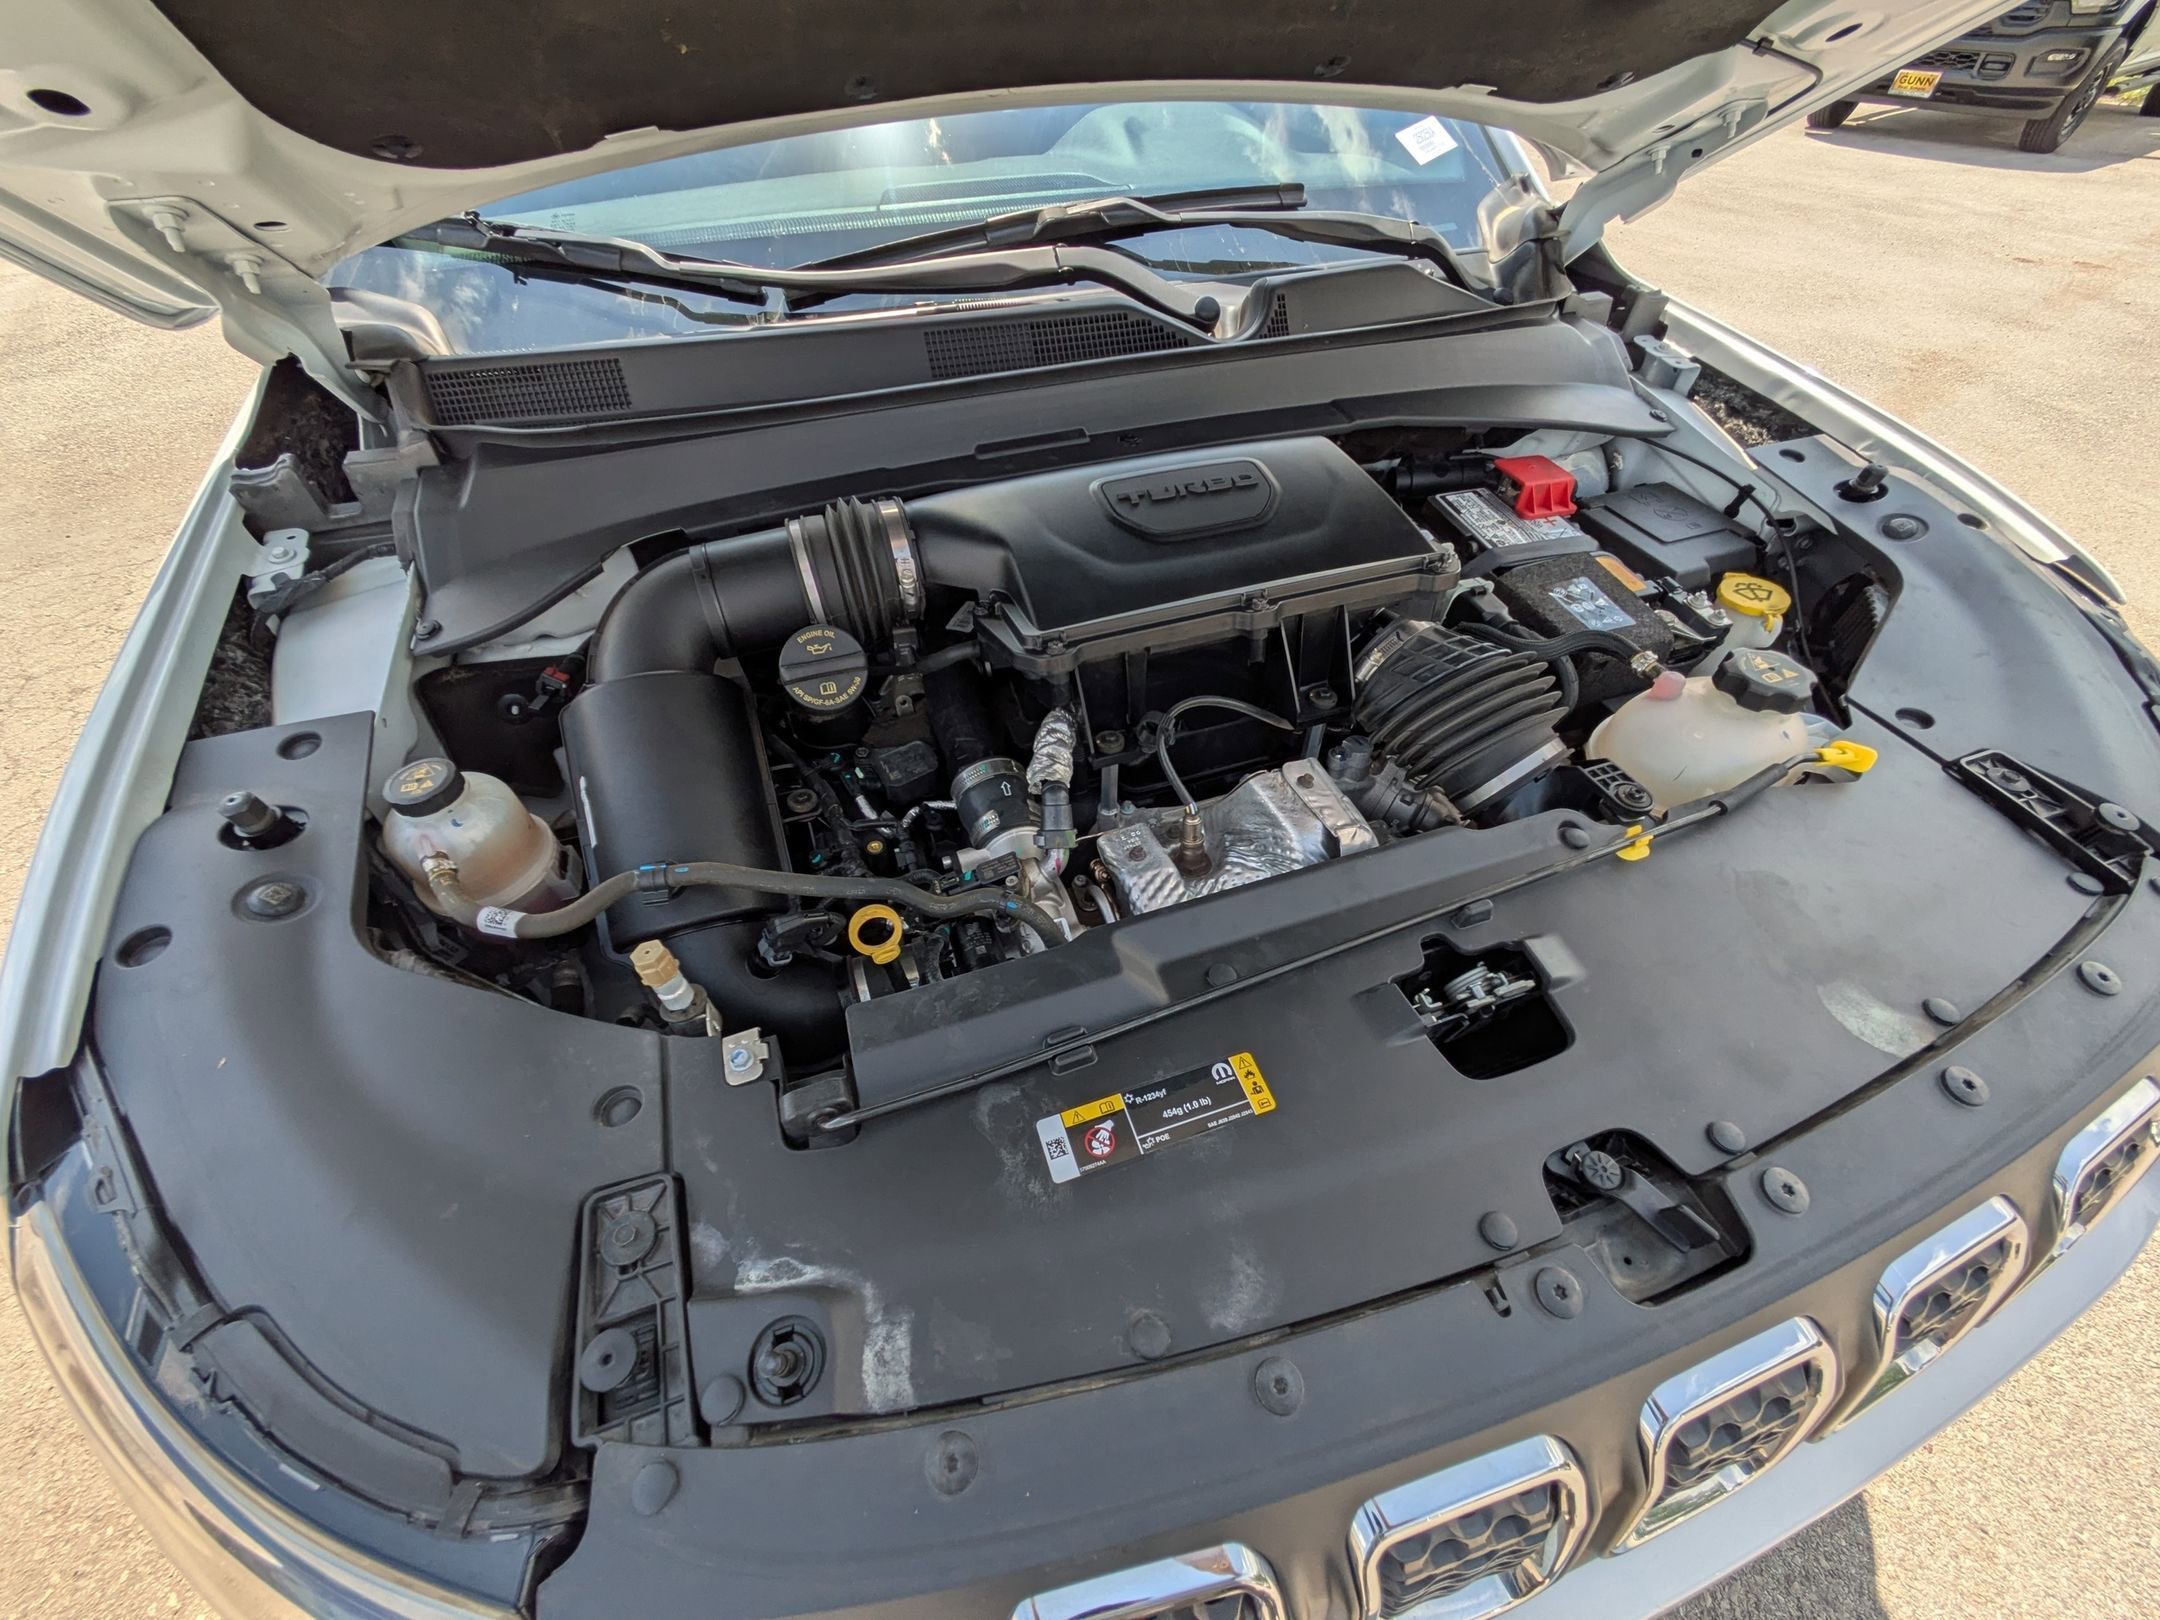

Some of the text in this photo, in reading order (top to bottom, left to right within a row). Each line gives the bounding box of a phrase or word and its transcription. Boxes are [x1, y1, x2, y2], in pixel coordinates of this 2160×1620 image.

[1899, 75, 1935, 87] GUNN
[1116, 473, 1260, 507] TURBO
[796, 629, 836, 644] ENGINE OIL
[792, 686, 804, 698] API
[1135, 1088, 1167, 1105] R-1234yf
[1162, 1096, 1212, 1118] 454g (1.0 lb)
[1155, 1133, 1170, 1143] POE
